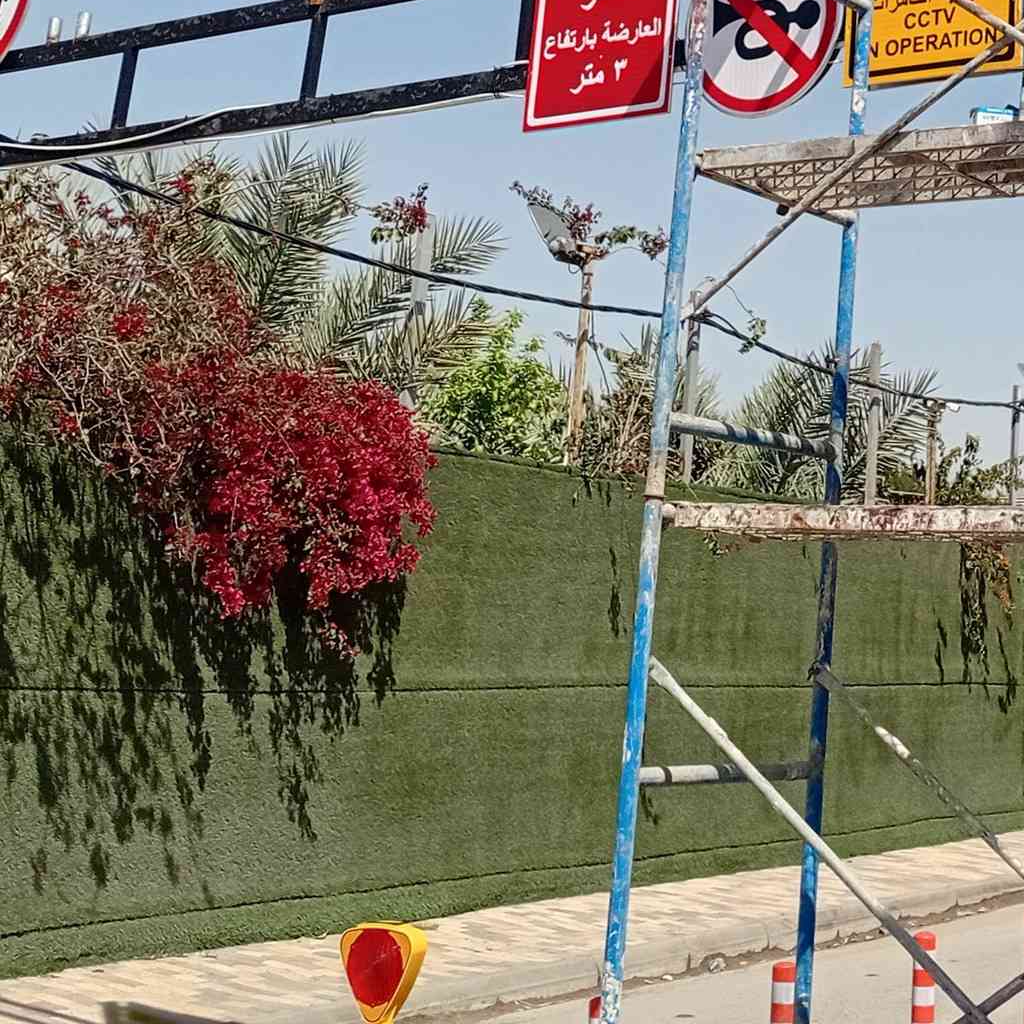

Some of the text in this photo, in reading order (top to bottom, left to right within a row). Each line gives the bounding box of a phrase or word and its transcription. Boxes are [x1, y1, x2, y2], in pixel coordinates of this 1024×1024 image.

[904, 7, 956, 29] CCTV
[544, 17, 662, 59] العارضة بارتفاع
[885, 27, 997, 56] OPERATION
[569, 63, 604, 94] متر
